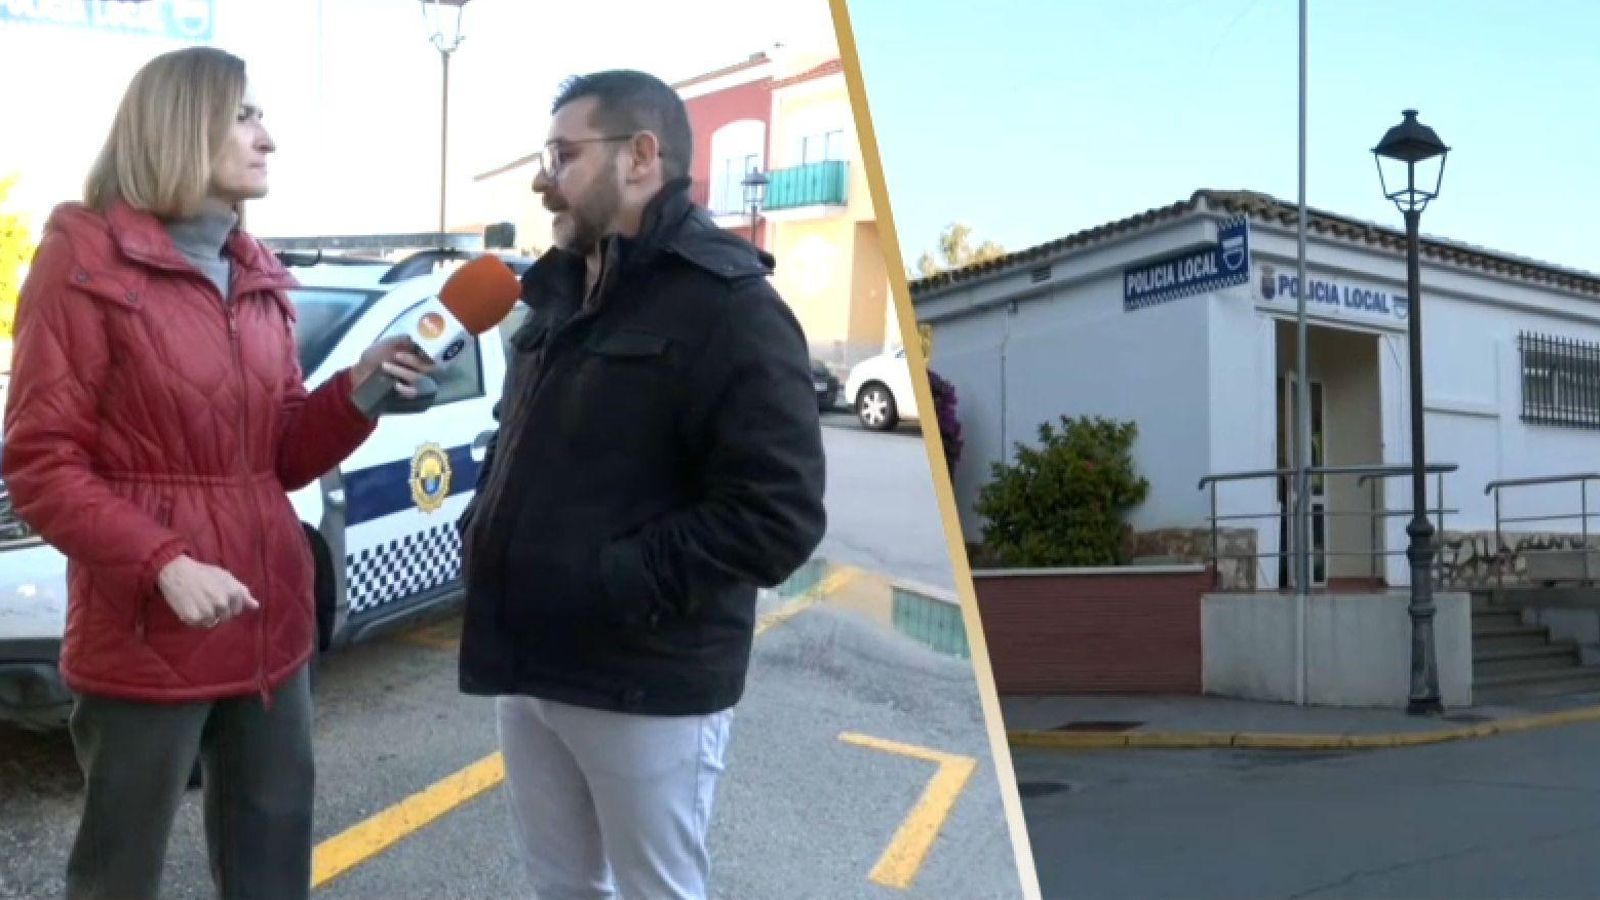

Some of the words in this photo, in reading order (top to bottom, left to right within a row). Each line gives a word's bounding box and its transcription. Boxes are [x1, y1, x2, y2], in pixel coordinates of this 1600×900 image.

[1126, 264, 1175, 297] POLICIA
[1178, 251, 1218, 283] LOCAL
[1343, 286, 1391, 314] LOCAL
